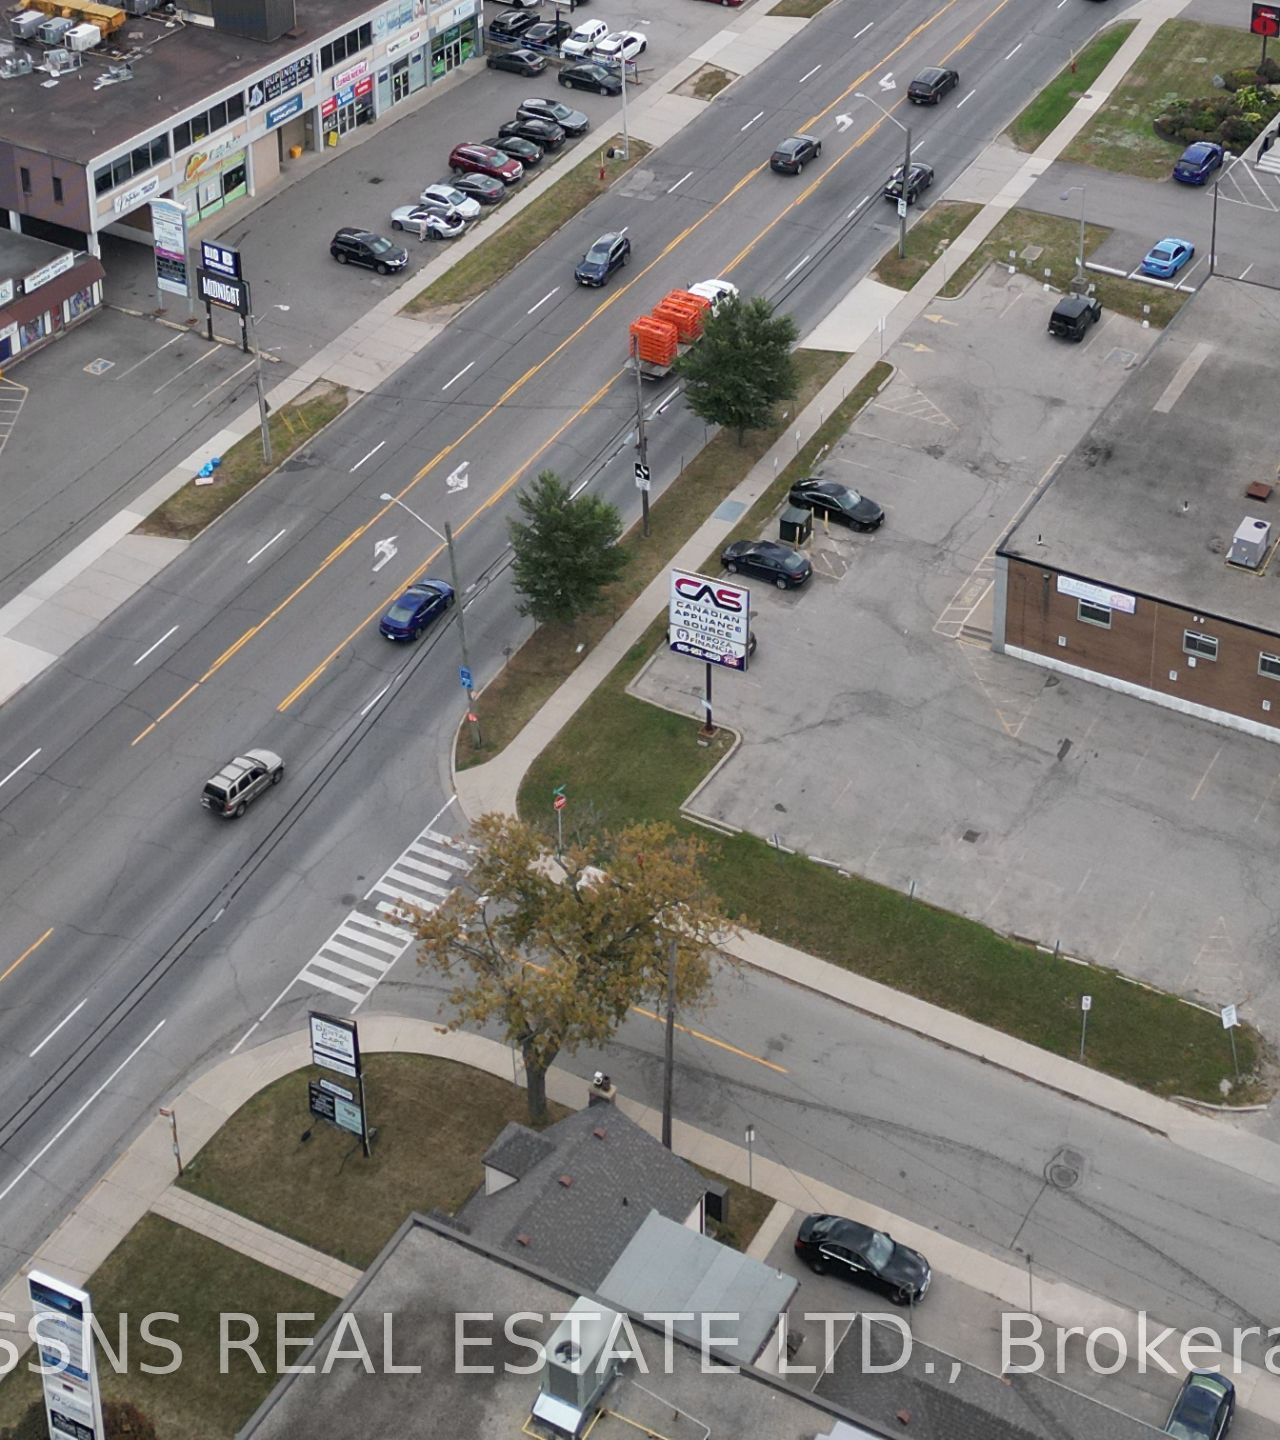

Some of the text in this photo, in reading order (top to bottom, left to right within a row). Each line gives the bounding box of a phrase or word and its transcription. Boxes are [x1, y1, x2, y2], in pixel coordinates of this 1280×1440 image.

[222, 251, 233, 266] B
[203, 276, 240, 306] MIDNIGHT
[675, 578, 742, 612] CAS
[674, 609, 742, 633] APPLIANCE
[676, 601, 740, 624] CANADIAN
[683, 620, 732, 639] SOURCE
[689, 637, 737, 656] FINANCIAL
[695, 632, 733, 648] FEROZA
[315, 1024, 349, 1043] DENTAL
